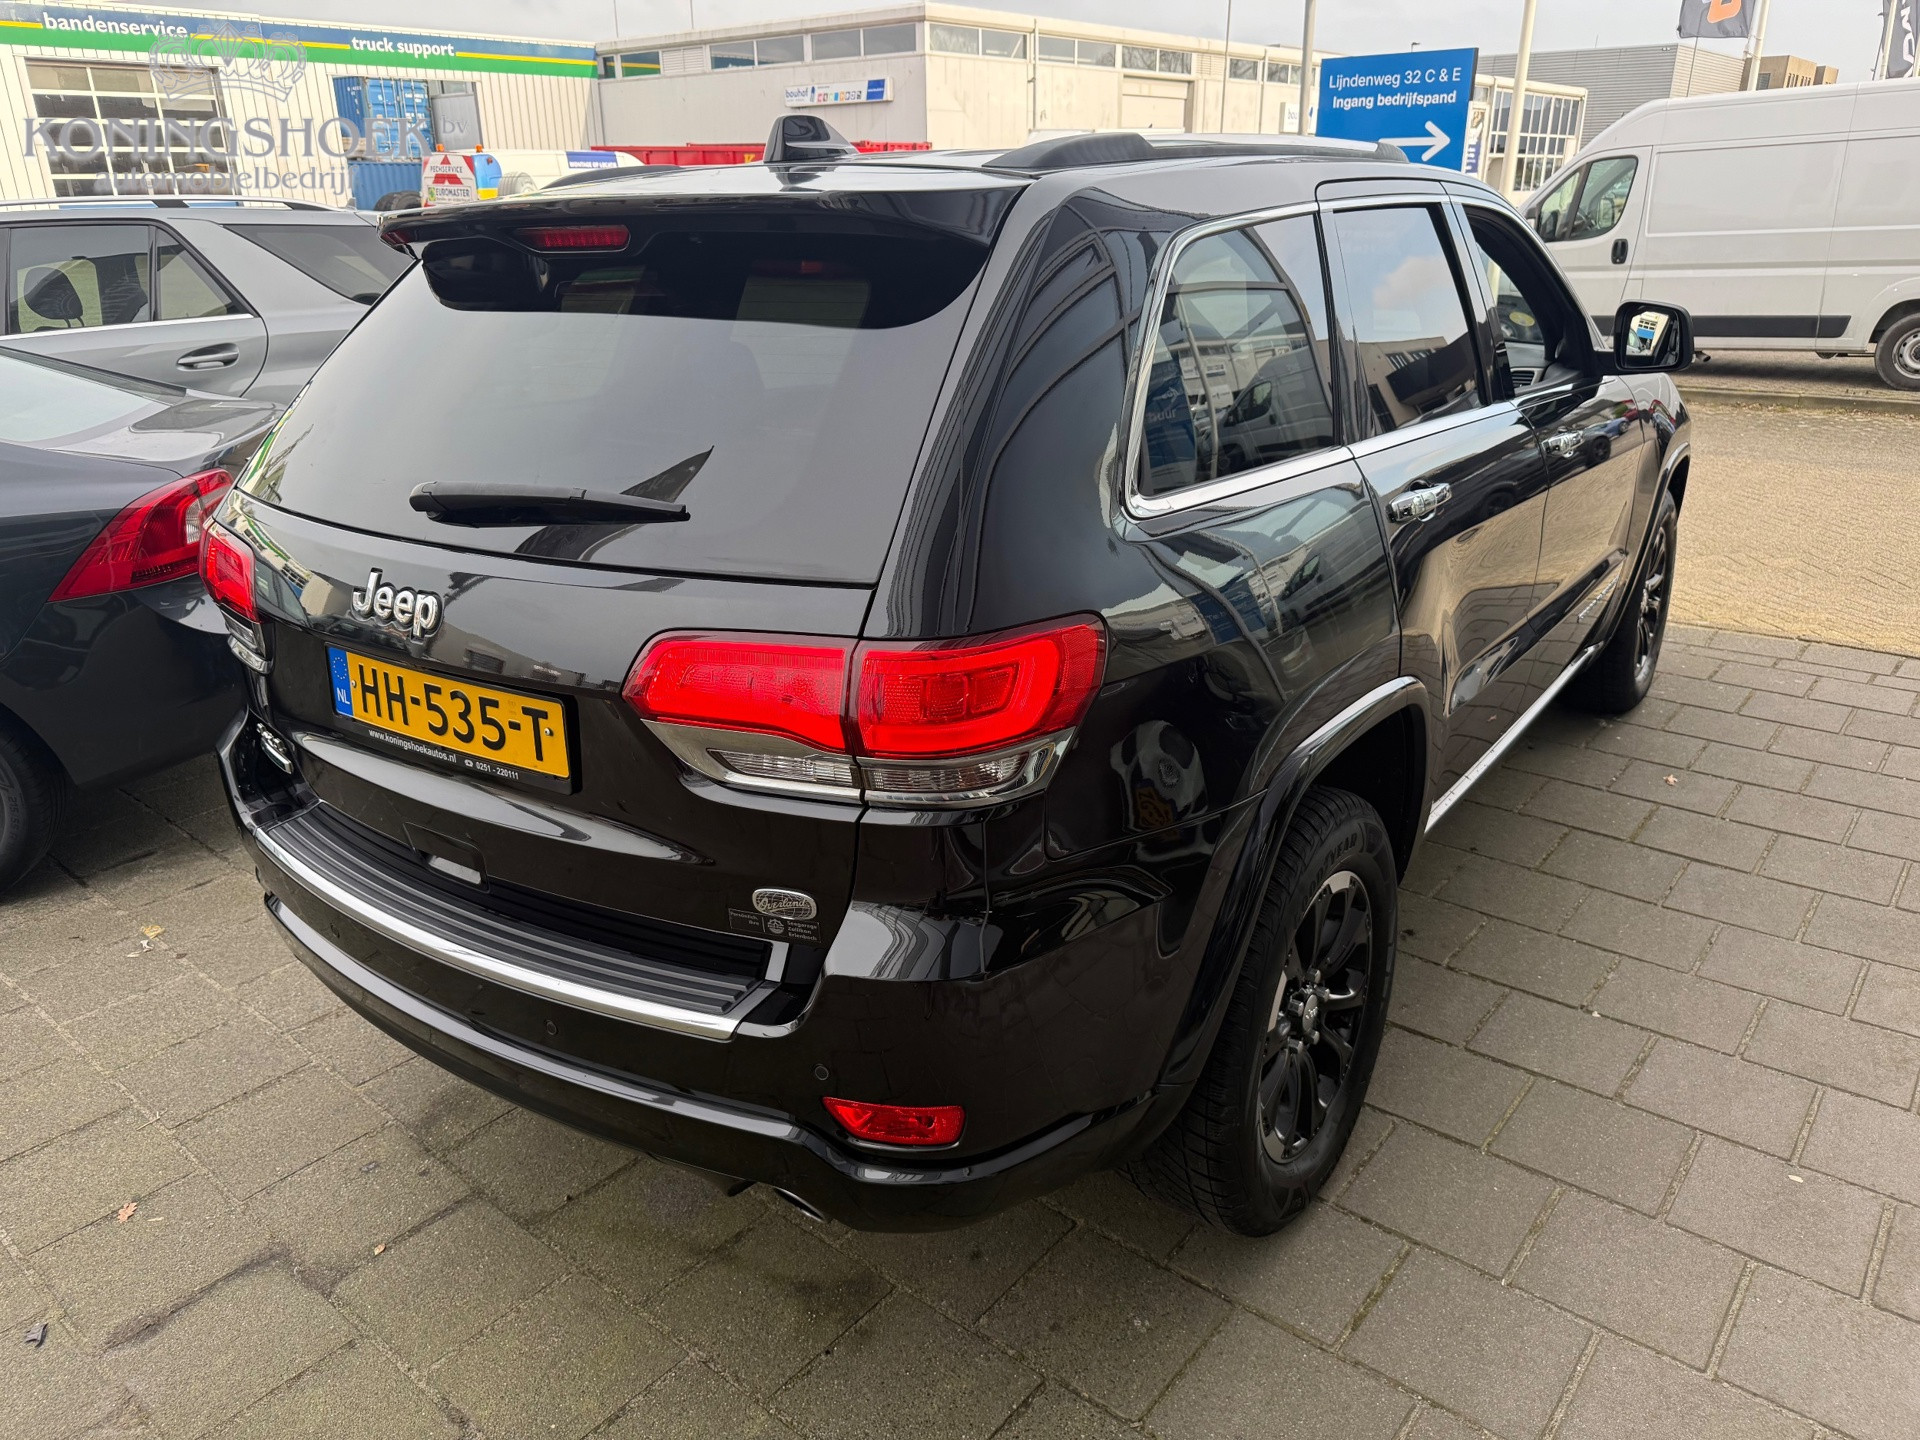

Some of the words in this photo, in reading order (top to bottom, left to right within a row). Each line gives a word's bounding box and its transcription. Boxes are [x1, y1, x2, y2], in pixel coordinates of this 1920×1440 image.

[43, 13, 188, 38] bandenservice
[351, 36, 392, 54] truck
[397, 40, 455, 57] support
[1329, 73, 1400, 91] Lijndenweg
[1404, 71, 1421, 85] 32
[1425, 70, 1435, 84] C
[1438, 69, 1449, 83] &
[1452, 68, 1461, 82] E
[1333, 94, 1373, 110] Ingang
[1377, 90, 1456, 108] bedrijfspand
[352, 567, 442, 638] Jeep
[336, 686, 350, 704] NL
[358, 664, 548, 762] HH-535-T
[368, 728, 457, 764] www.koningshoekautos.nl
[475, 760, 491, 775] 0251
[759, 897, 806, 911] Overland
